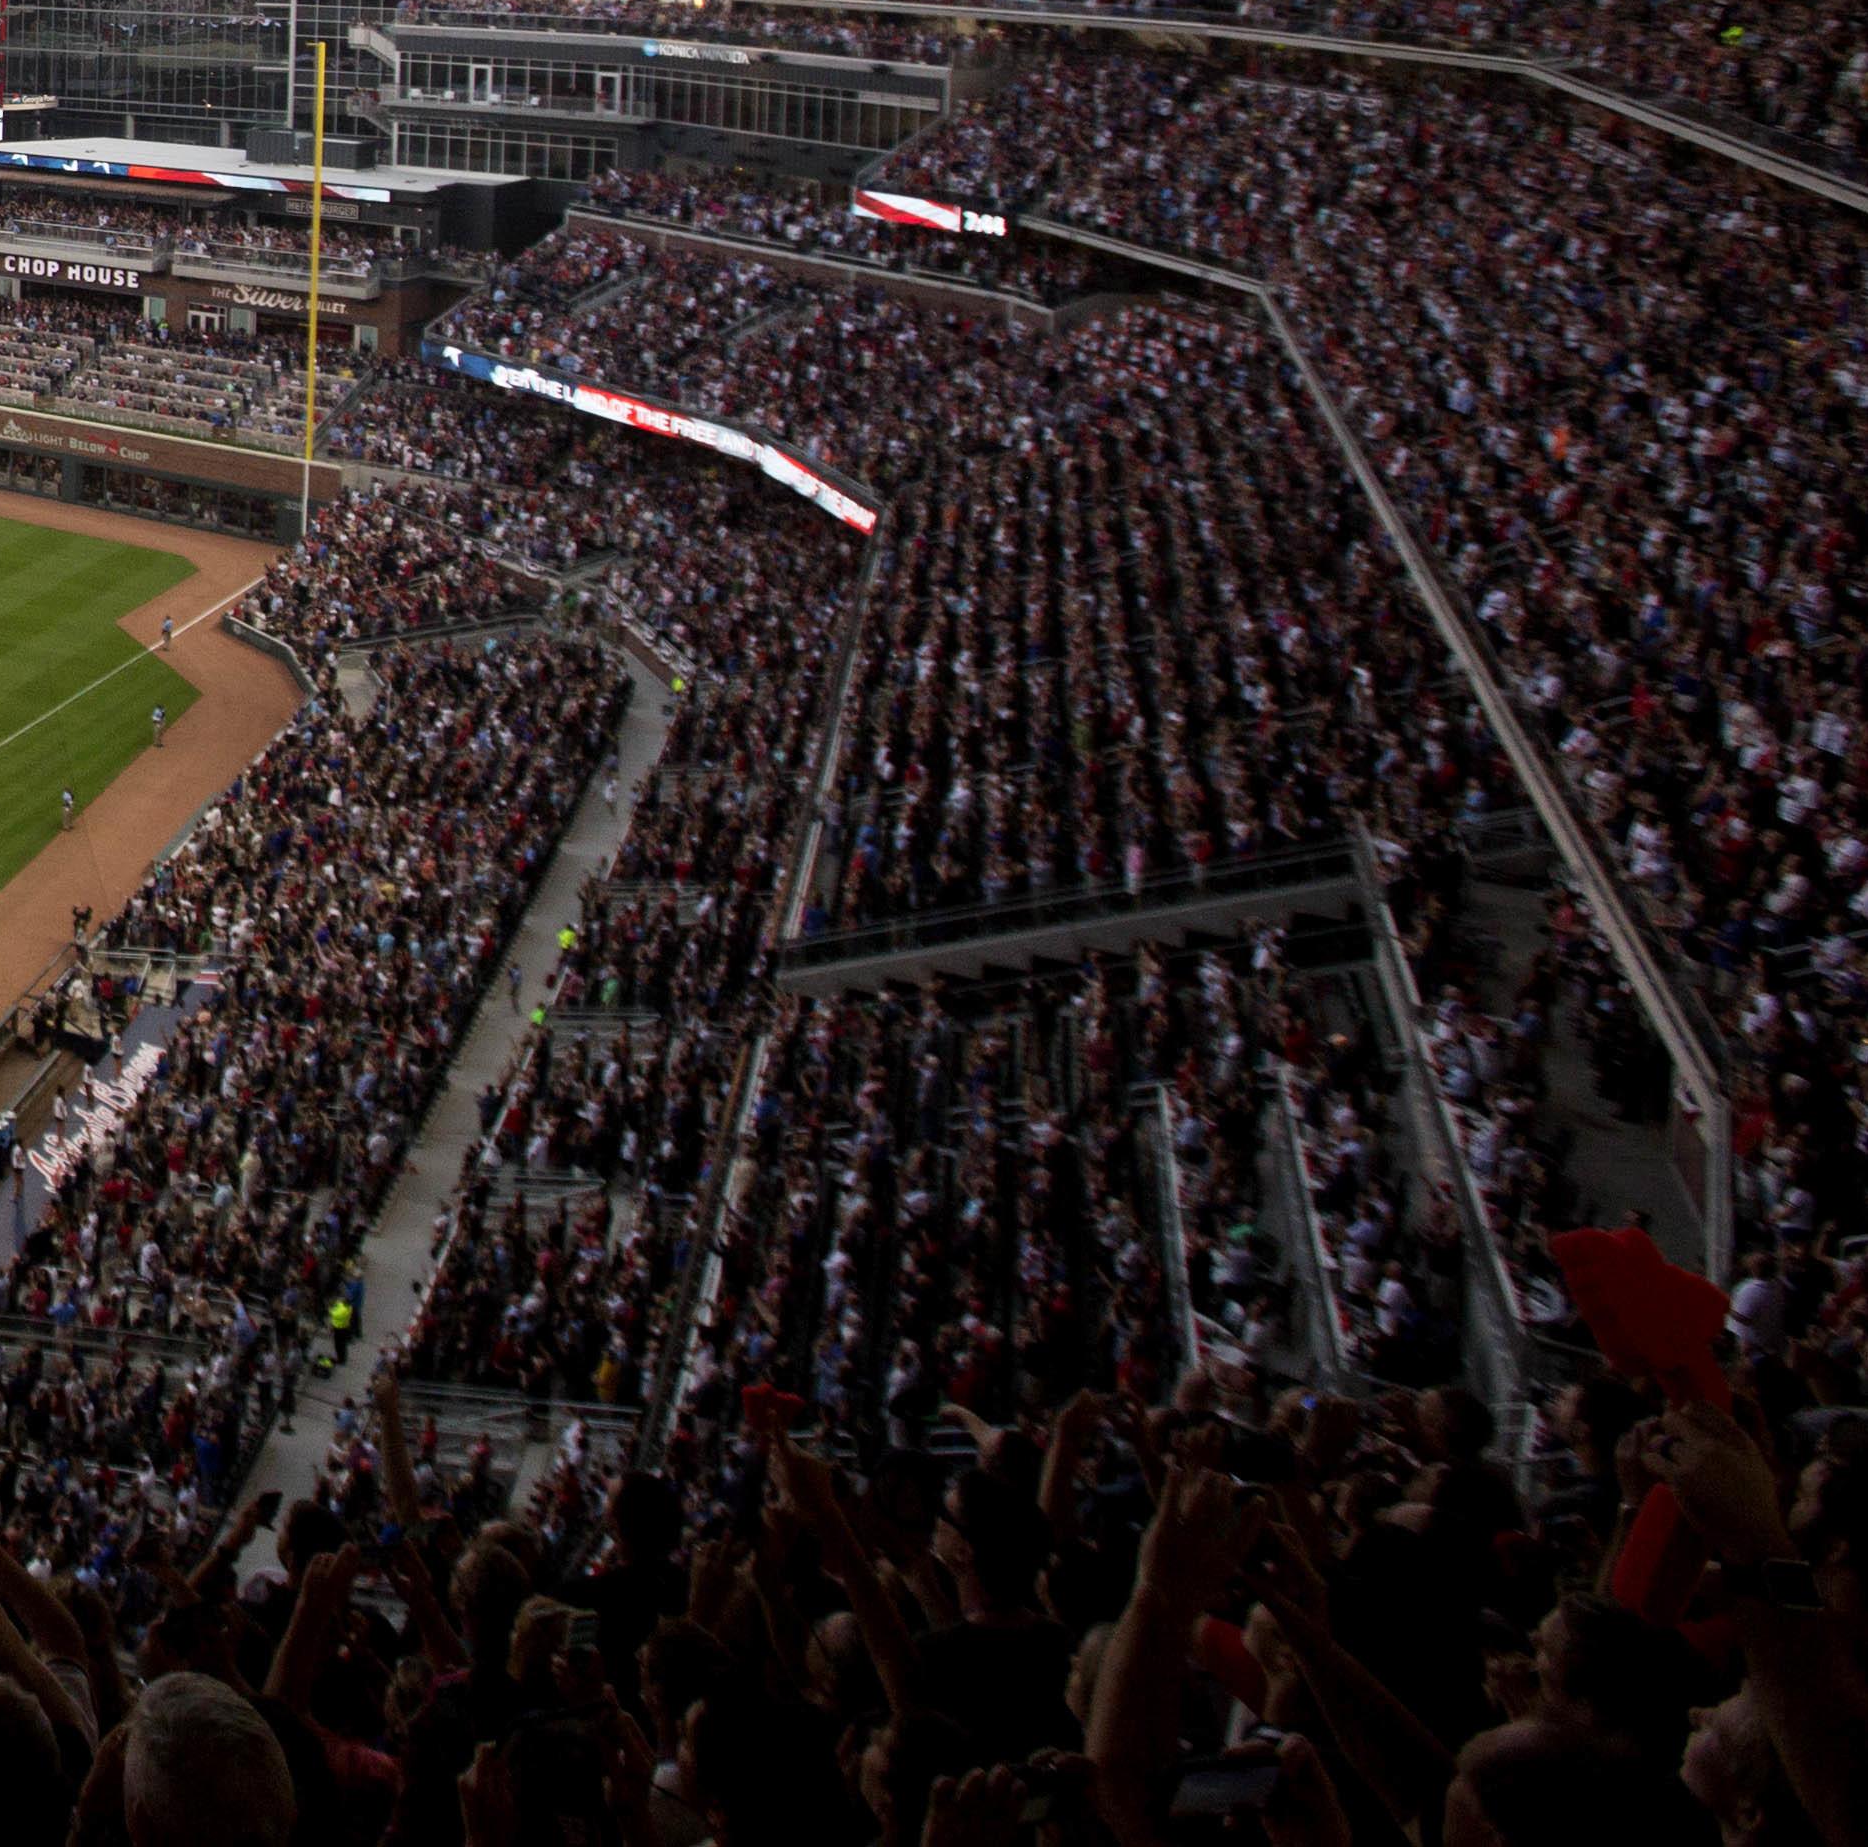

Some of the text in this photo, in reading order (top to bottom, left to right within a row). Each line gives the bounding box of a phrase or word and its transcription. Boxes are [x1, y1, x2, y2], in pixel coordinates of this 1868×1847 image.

[658, 44, 700, 59] KONICA
[4, 255, 140, 289] CHOP HOUSE
[210, 287, 232, 299] THE
[233, 284, 305, 312] Silver
[34, 433, 64, 447] LIGHT
